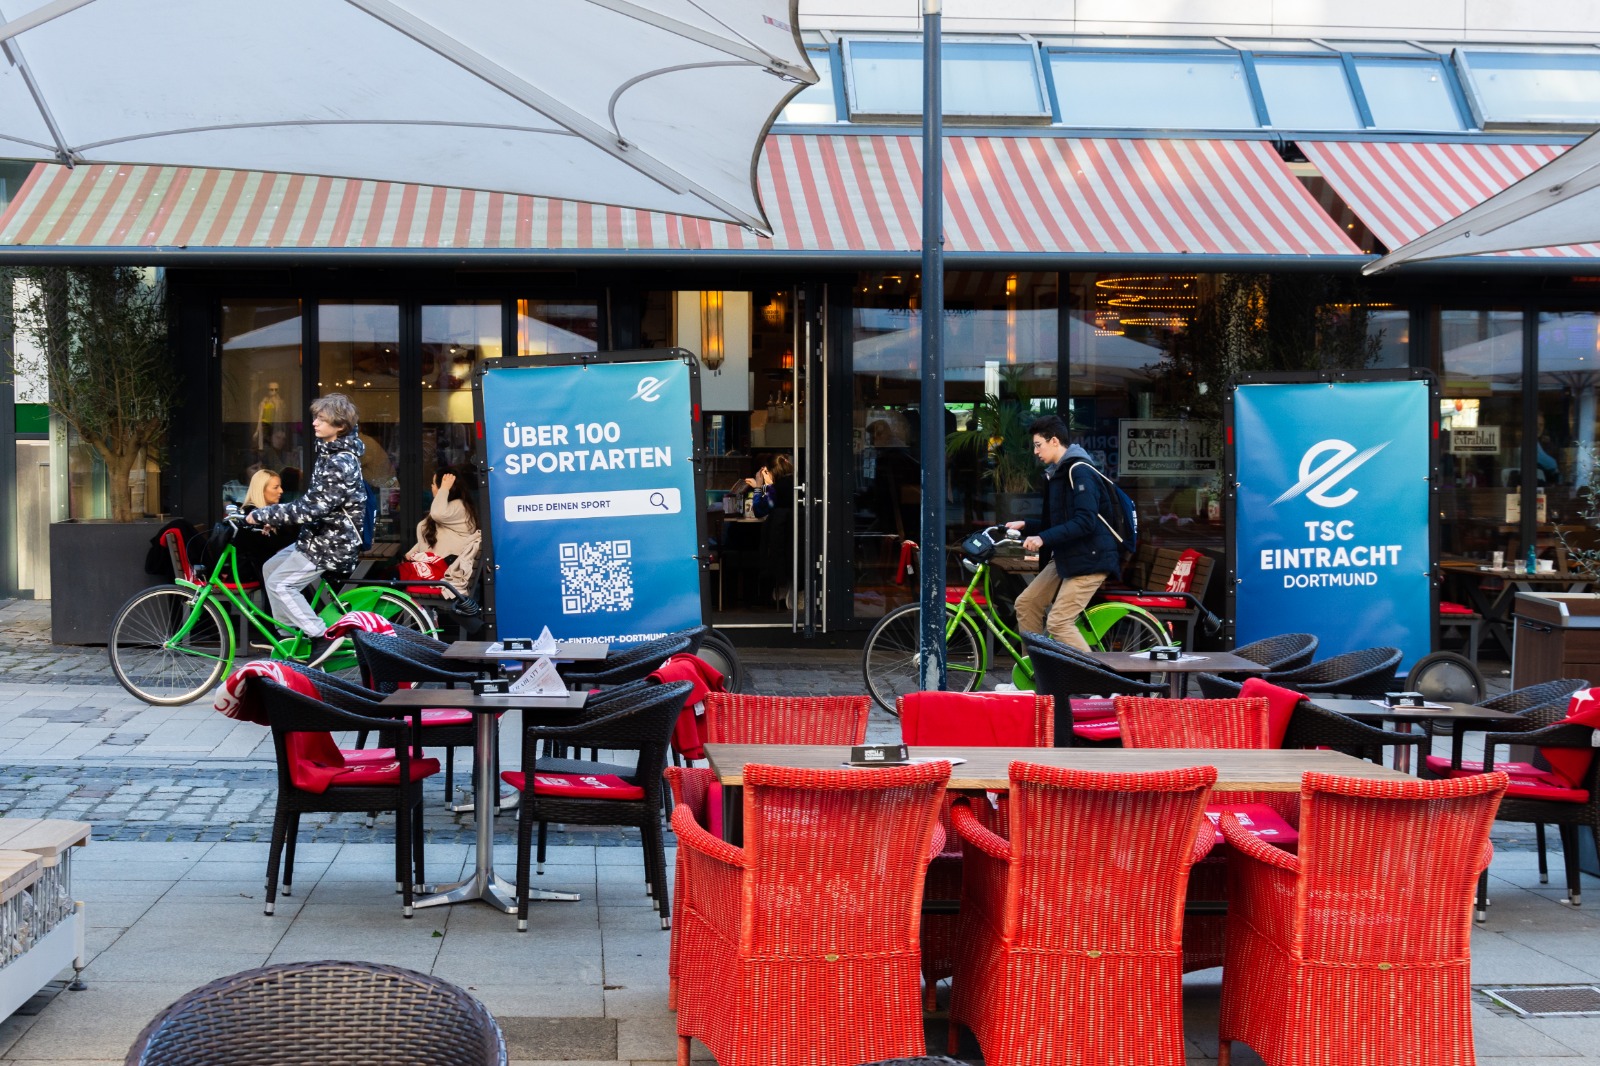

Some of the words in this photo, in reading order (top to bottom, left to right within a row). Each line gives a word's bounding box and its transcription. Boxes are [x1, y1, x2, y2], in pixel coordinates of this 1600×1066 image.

[503, 421, 569, 448] ÜBER
[575, 421, 621, 444] 100
[1128, 429, 1212, 458] extrablatt
[1454, 431, 1495, 445] extrablatt
[505, 446, 672, 475] SPORTARTEN
[517, 504, 544, 512] FINDE
[546, 502, 578, 511] DEINEN
[581, 500, 611, 509] SPORT
[1304, 520, 1354, 541] TSC
[1260, 545, 1402, 570] EINTRACHT
[1283, 572, 1378, 588] DORTMUND
